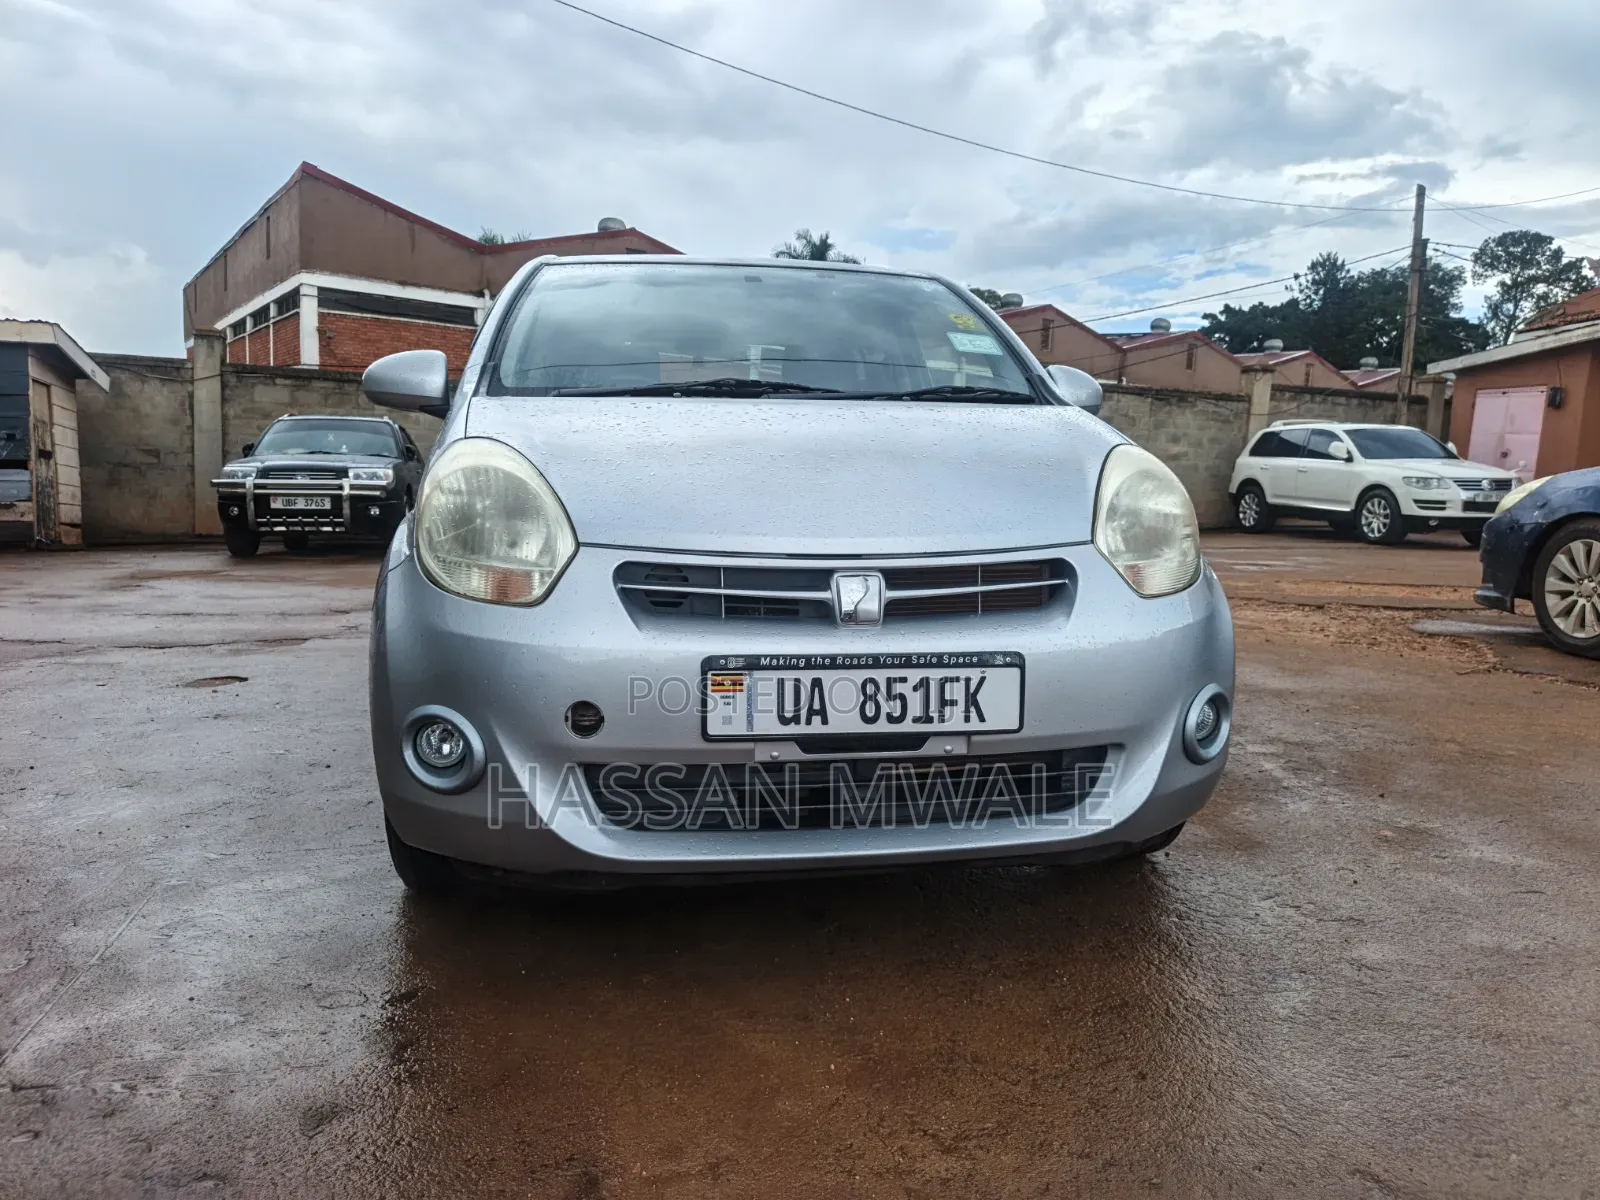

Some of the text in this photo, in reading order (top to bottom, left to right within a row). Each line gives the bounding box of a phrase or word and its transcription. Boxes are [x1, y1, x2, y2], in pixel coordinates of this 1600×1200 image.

[281, 497, 326, 508] UBF 376S
[760, 654, 979, 668] Making the Roads Your Safe Space
[776, 675, 988, 727] UA 851FK
